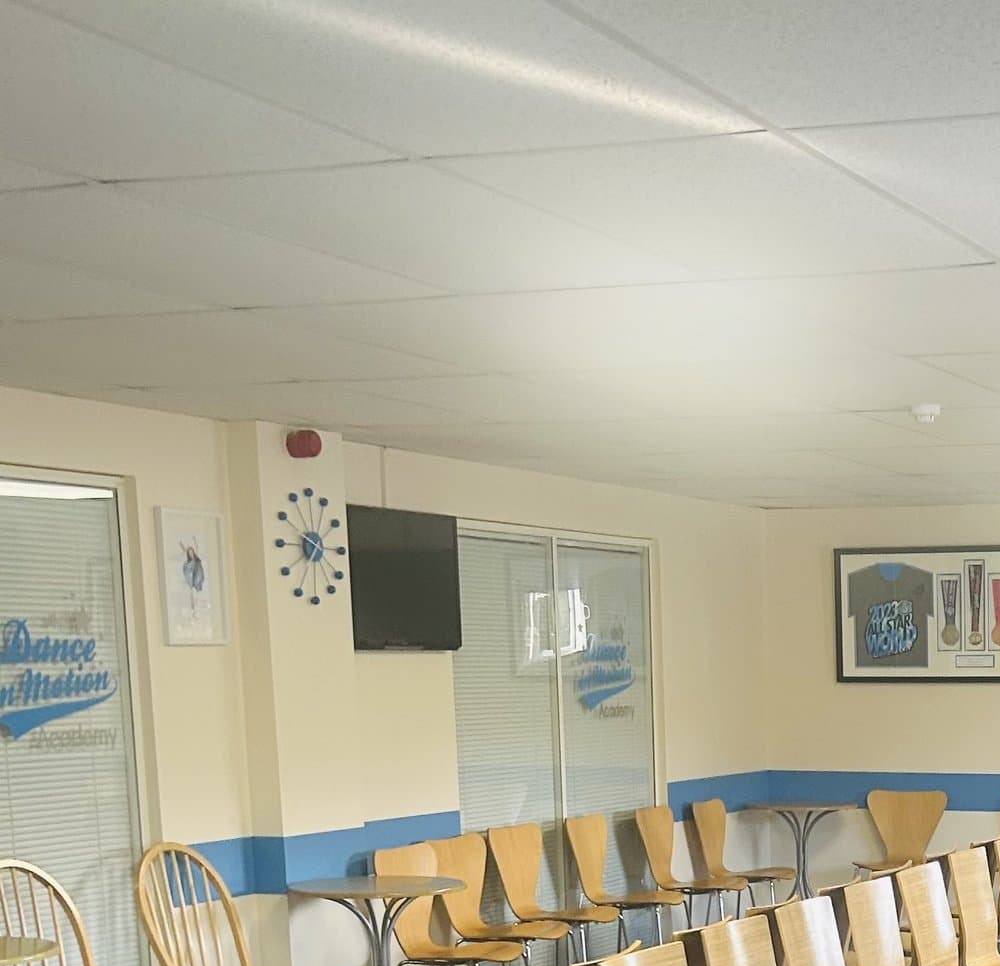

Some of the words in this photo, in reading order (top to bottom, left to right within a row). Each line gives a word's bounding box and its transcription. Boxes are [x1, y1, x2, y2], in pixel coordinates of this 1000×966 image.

[0, 618, 97, 664] Dance
[886, 612, 913, 634] STAR
[0, 684, 15, 707] n
[22, 666, 110, 706] Motion
